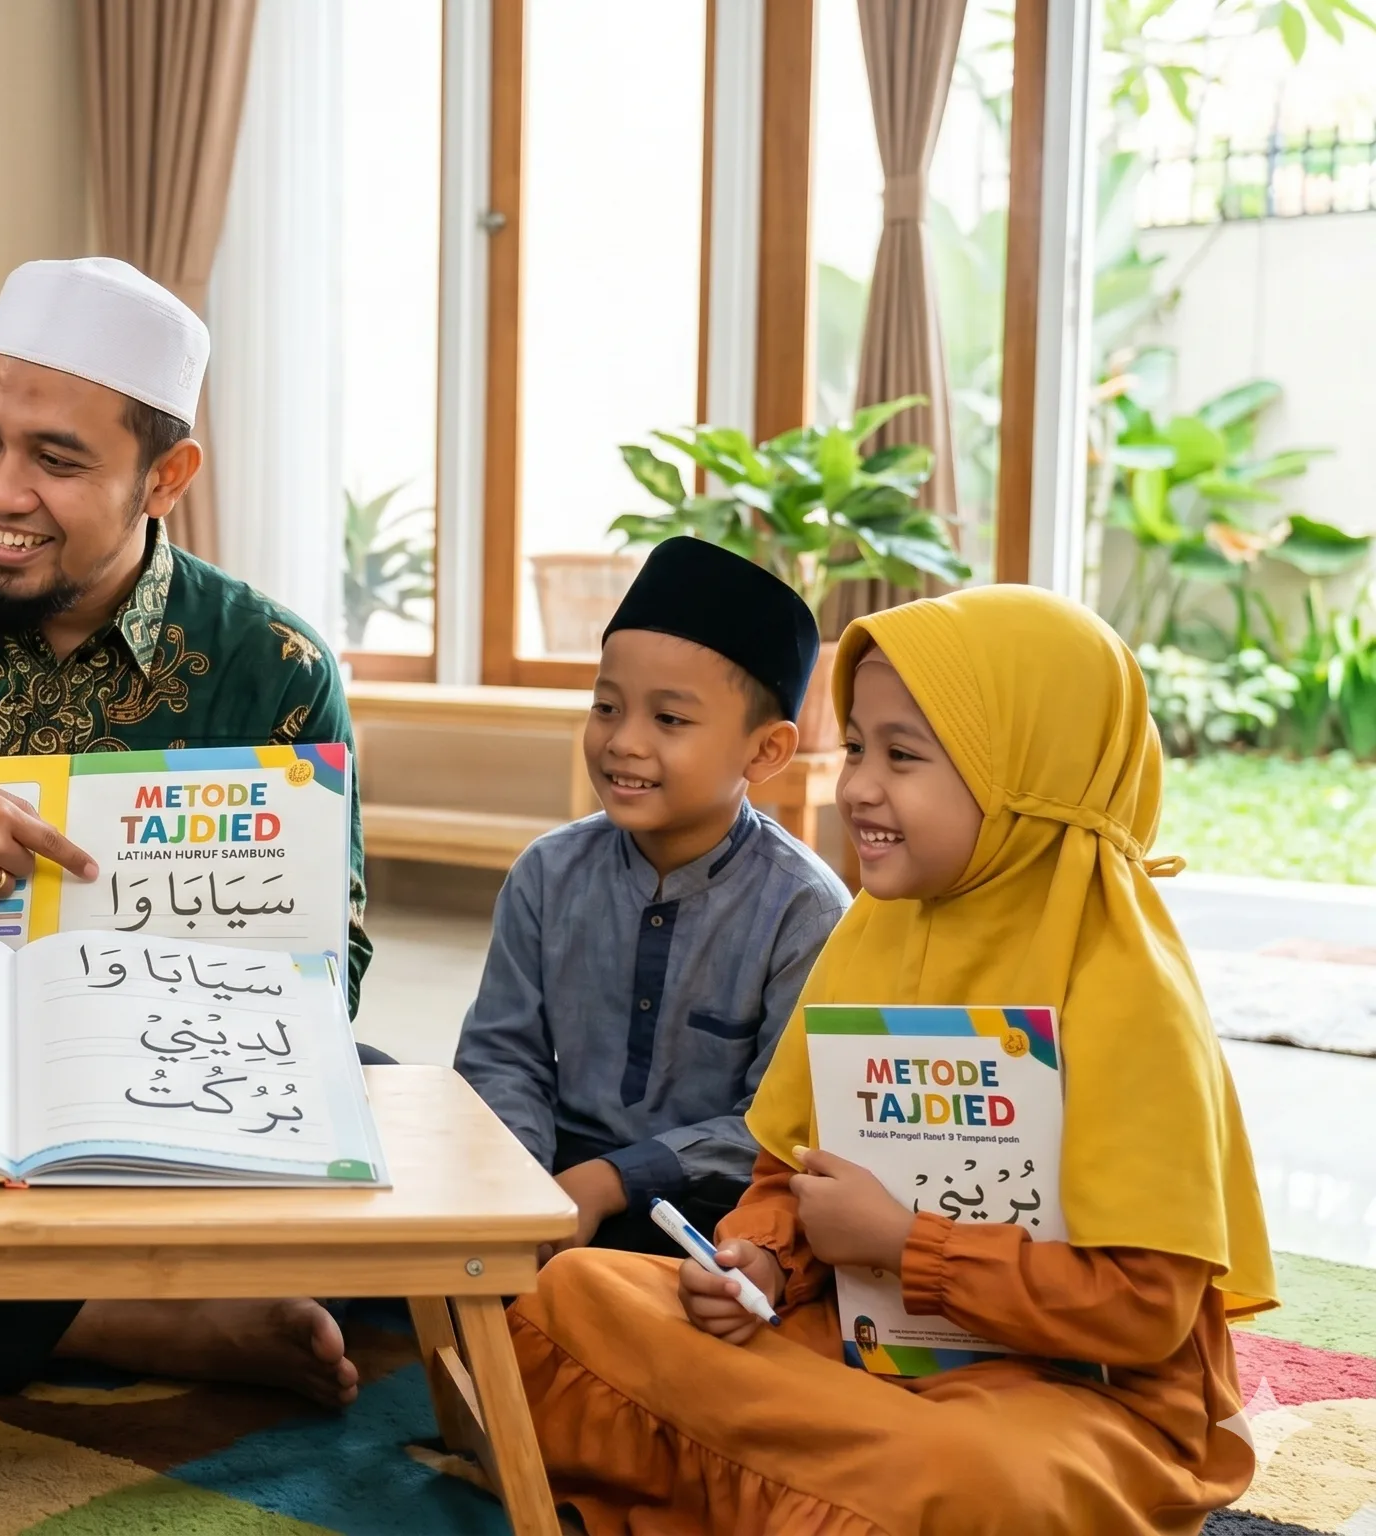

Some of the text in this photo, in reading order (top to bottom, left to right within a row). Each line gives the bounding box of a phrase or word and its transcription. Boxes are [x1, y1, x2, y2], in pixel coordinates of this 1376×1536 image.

[134, 782, 268, 809] METODE
[120, 812, 281, 845] TAJDIED
[175, 849, 218, 860] HURUF
[221, 848, 285, 859] SAMBUNG
[866, 1058, 999, 1088] METODE
[856, 1091, 1016, 1127] TAJDIED
[858, 1129, 866, 1138] 3
